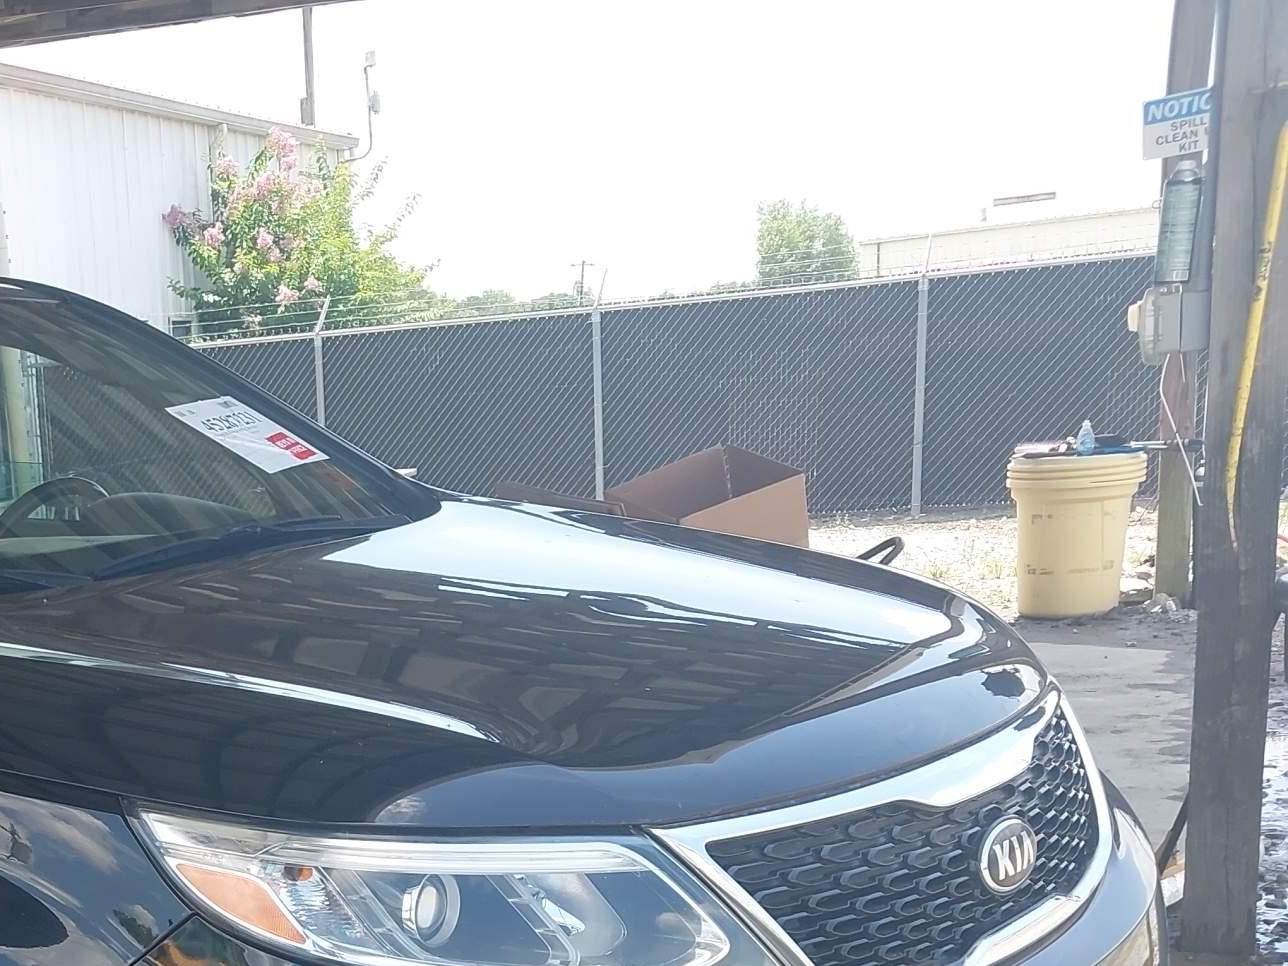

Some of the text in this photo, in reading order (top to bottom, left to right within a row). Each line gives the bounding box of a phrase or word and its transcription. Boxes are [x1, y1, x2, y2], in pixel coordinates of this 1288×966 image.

[1147, 92, 1212, 122] NOTIC
[1170, 116, 1208, 132] SPILL
[1155, 129, 1199, 146] CLEAN
[1178, 140, 1200, 153] KIT
[200, 410, 263, 432] 45287231
[992, 830, 1034, 881] KIA
